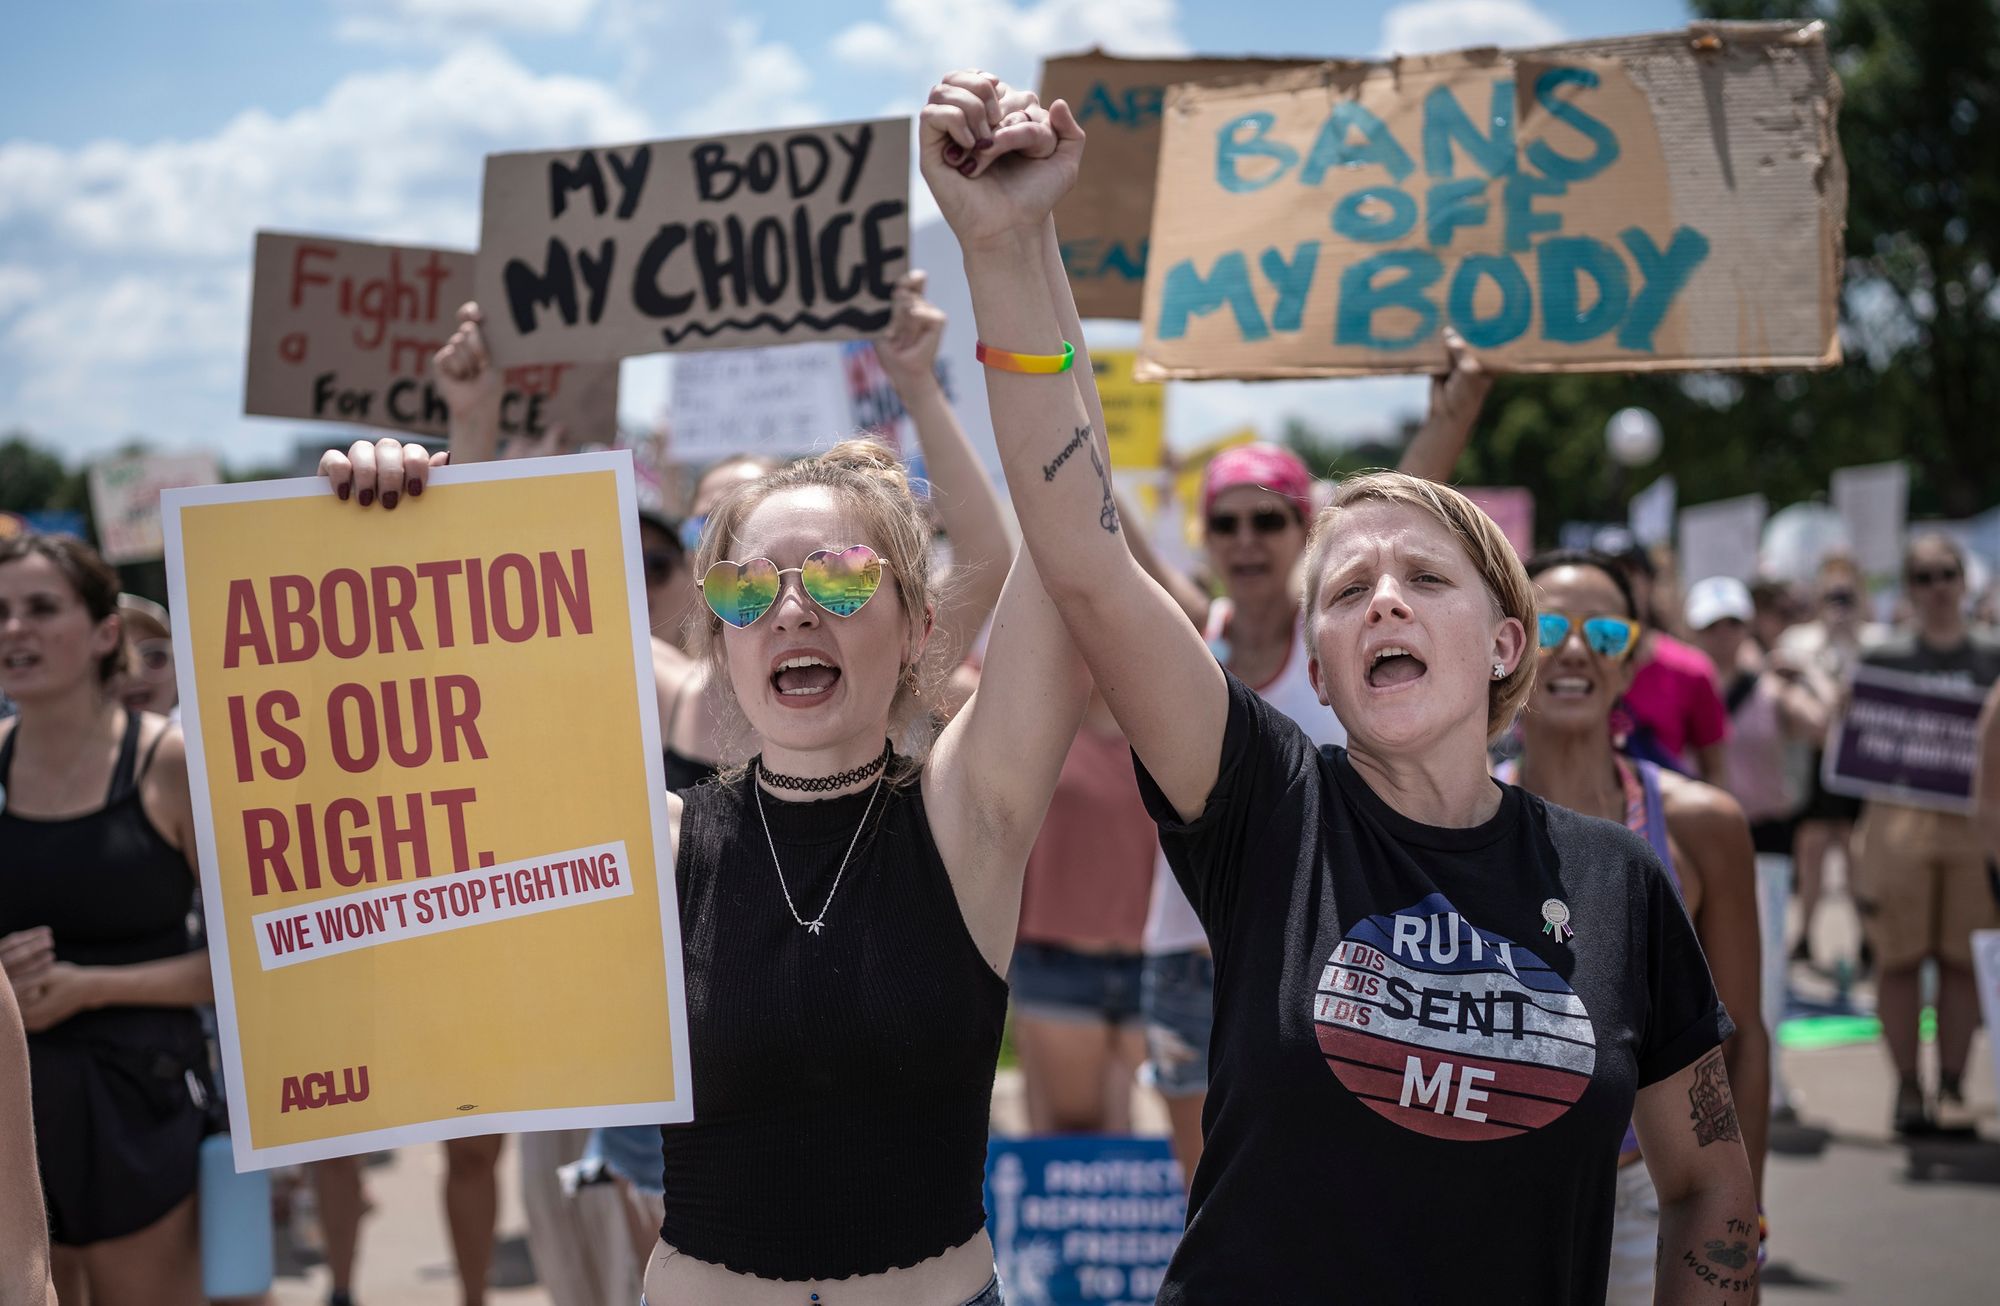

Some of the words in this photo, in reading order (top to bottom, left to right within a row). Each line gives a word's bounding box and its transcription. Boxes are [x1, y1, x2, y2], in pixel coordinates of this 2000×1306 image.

[550, 145, 651, 219] MY
[692, 125, 874, 203] BODY
[1214, 66, 1621, 192] BANS
[1332, 172, 1568, 252] OFF
[290, 247, 449, 351] Fight
[504, 236, 615, 335] MY
[633, 200, 908, 318] CHOICE
[1158, 240, 1320, 343] MY
[1334, 223, 1710, 352] BODY
[312, 370, 374, 417] For
[387, 377, 548, 437] ChCE
[223, 549, 594, 669] ABORTION
[228, 690, 307, 782] IS
[327, 675, 488, 773] OUR
[242, 788, 495, 897] RIGHT.
[266, 914, 313, 956] WE
[316, 894, 408, 944] WON'T
[413, 878, 488, 925] STOP
[491, 853, 621, 909] FIGHTING
[1330, 969, 1340, 987] I
[1348, 973, 1380, 996] DIS
[1339, 943, 1348, 961] I
[1351, 946, 1385, 971] DIS
[1320, 998, 1330, 1016] I
[1334, 1000, 1372, 1026] DIS
[1380, 977, 1533, 1040] SENT
[280, 1065, 370, 1114] ACLU
[1399, 1055, 1496, 1123] ME
[1022, 1196, 1186, 1230] REPRODUC
